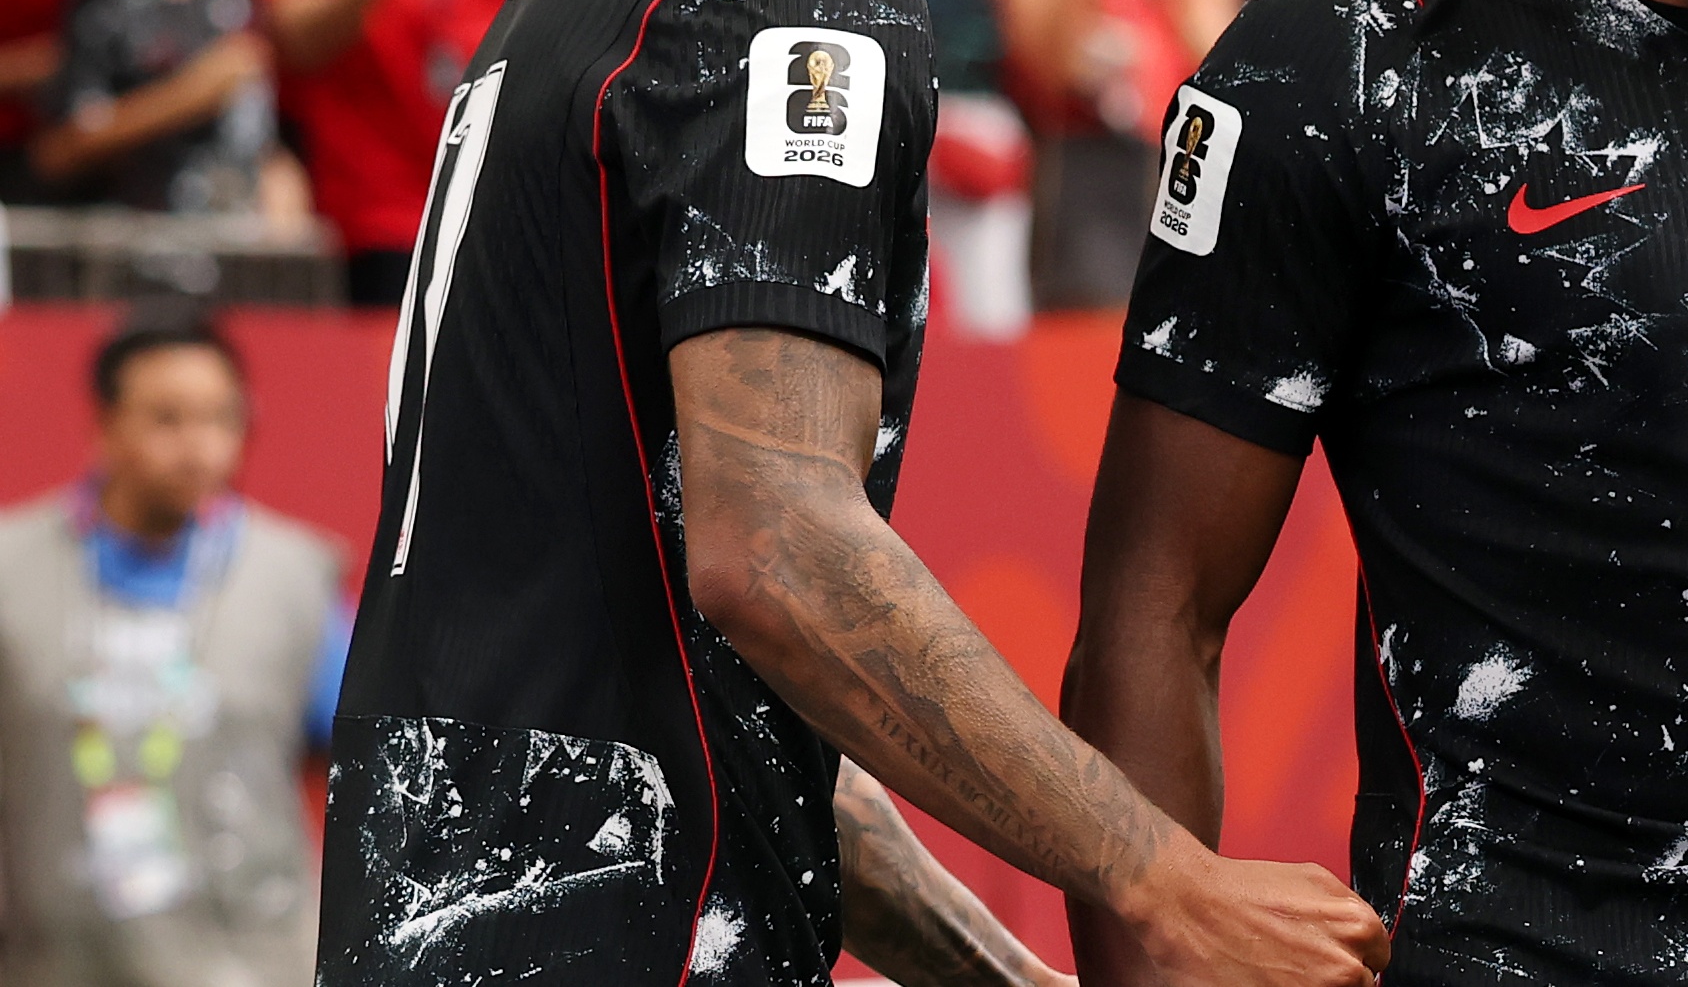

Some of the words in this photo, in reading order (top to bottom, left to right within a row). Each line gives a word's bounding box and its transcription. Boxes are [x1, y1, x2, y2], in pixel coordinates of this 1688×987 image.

[803, 115, 834, 128] FIFA
[785, 139, 825, 148] WORLD
[827, 140, 846, 151] CUP
[784, 149, 844, 167] 2026
[1178, 209, 1191, 220] CUP
[1160, 210, 1189, 236] 2026
